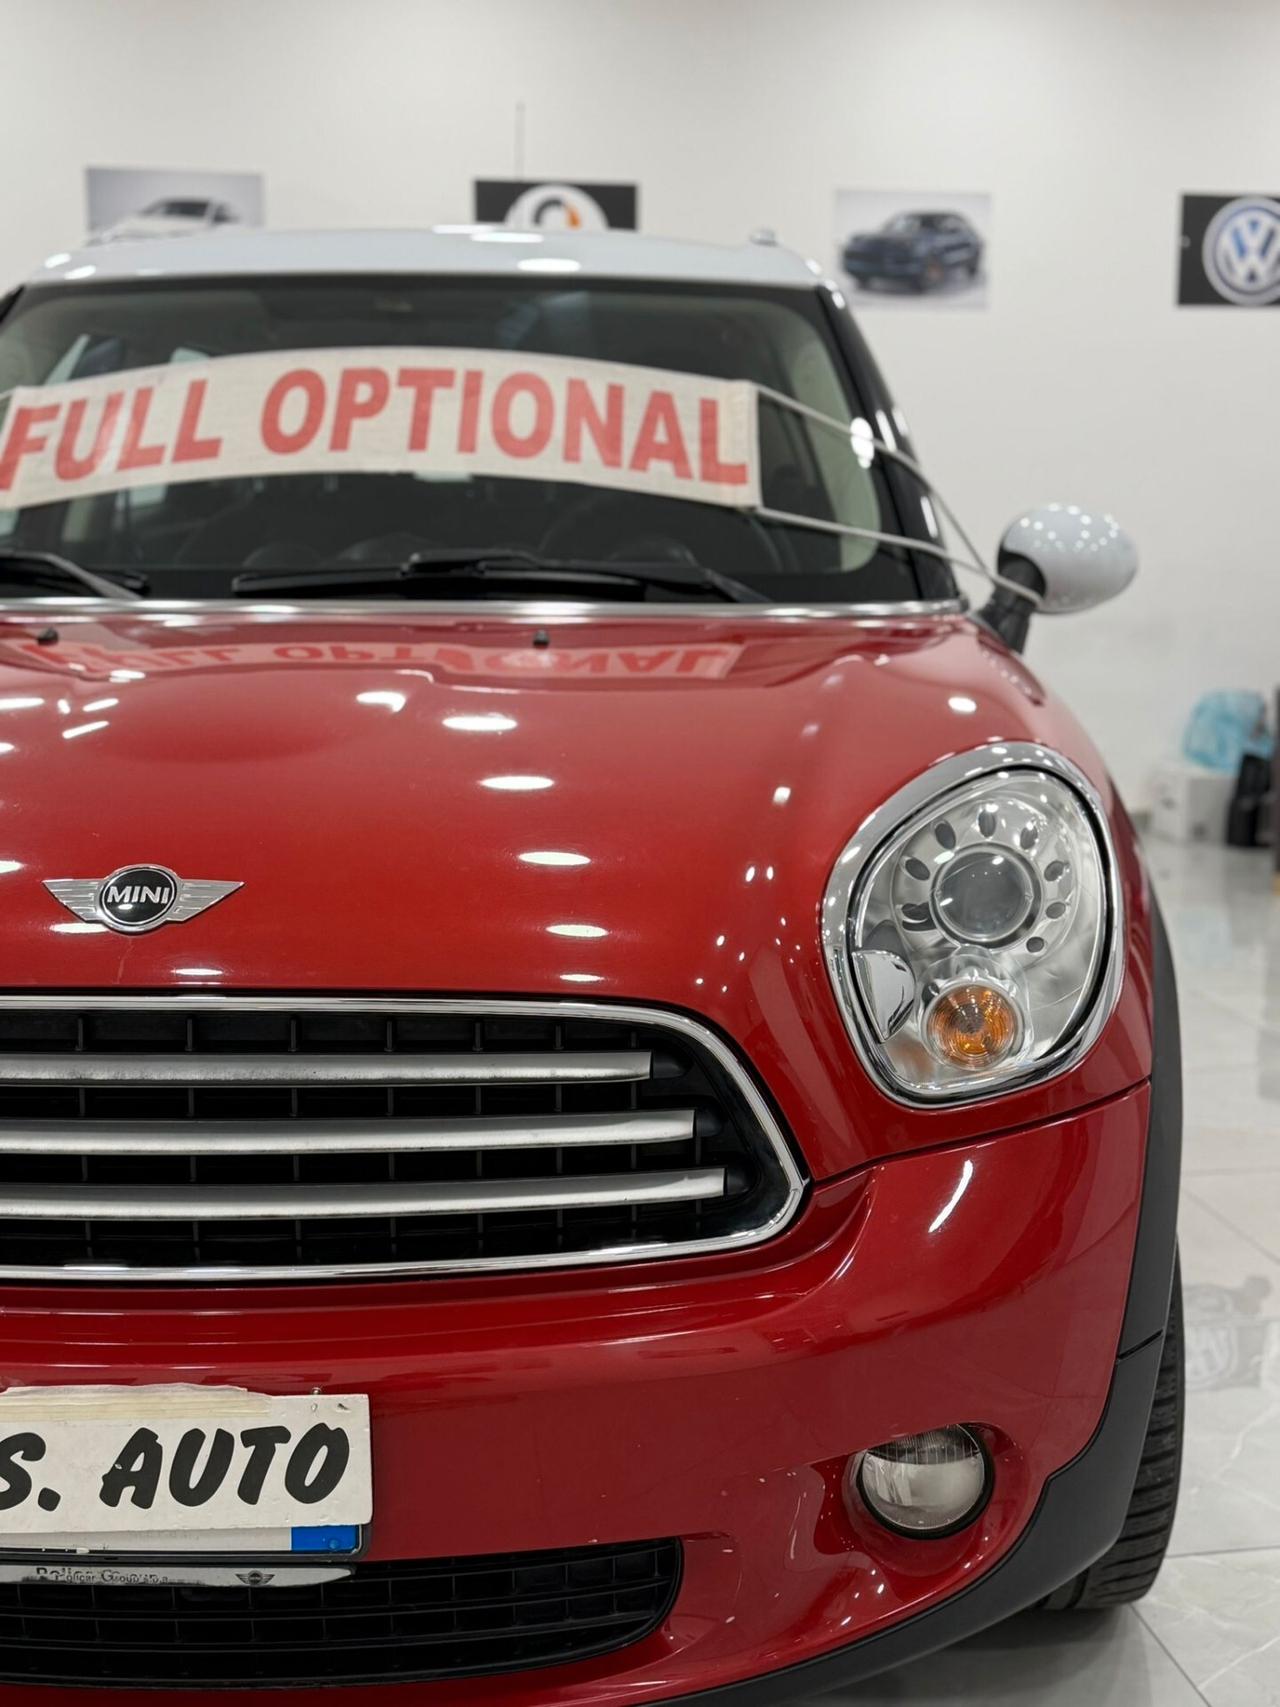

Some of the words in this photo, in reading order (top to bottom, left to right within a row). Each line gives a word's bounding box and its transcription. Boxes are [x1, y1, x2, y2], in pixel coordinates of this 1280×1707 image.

[0, 379, 223, 491] FULL
[260, 367, 749, 486] OPTIONAL
[106, 885, 171, 905] MINI
[0, 1432, 62, 1512] S.
[99, 1422, 350, 1509] AUTO
